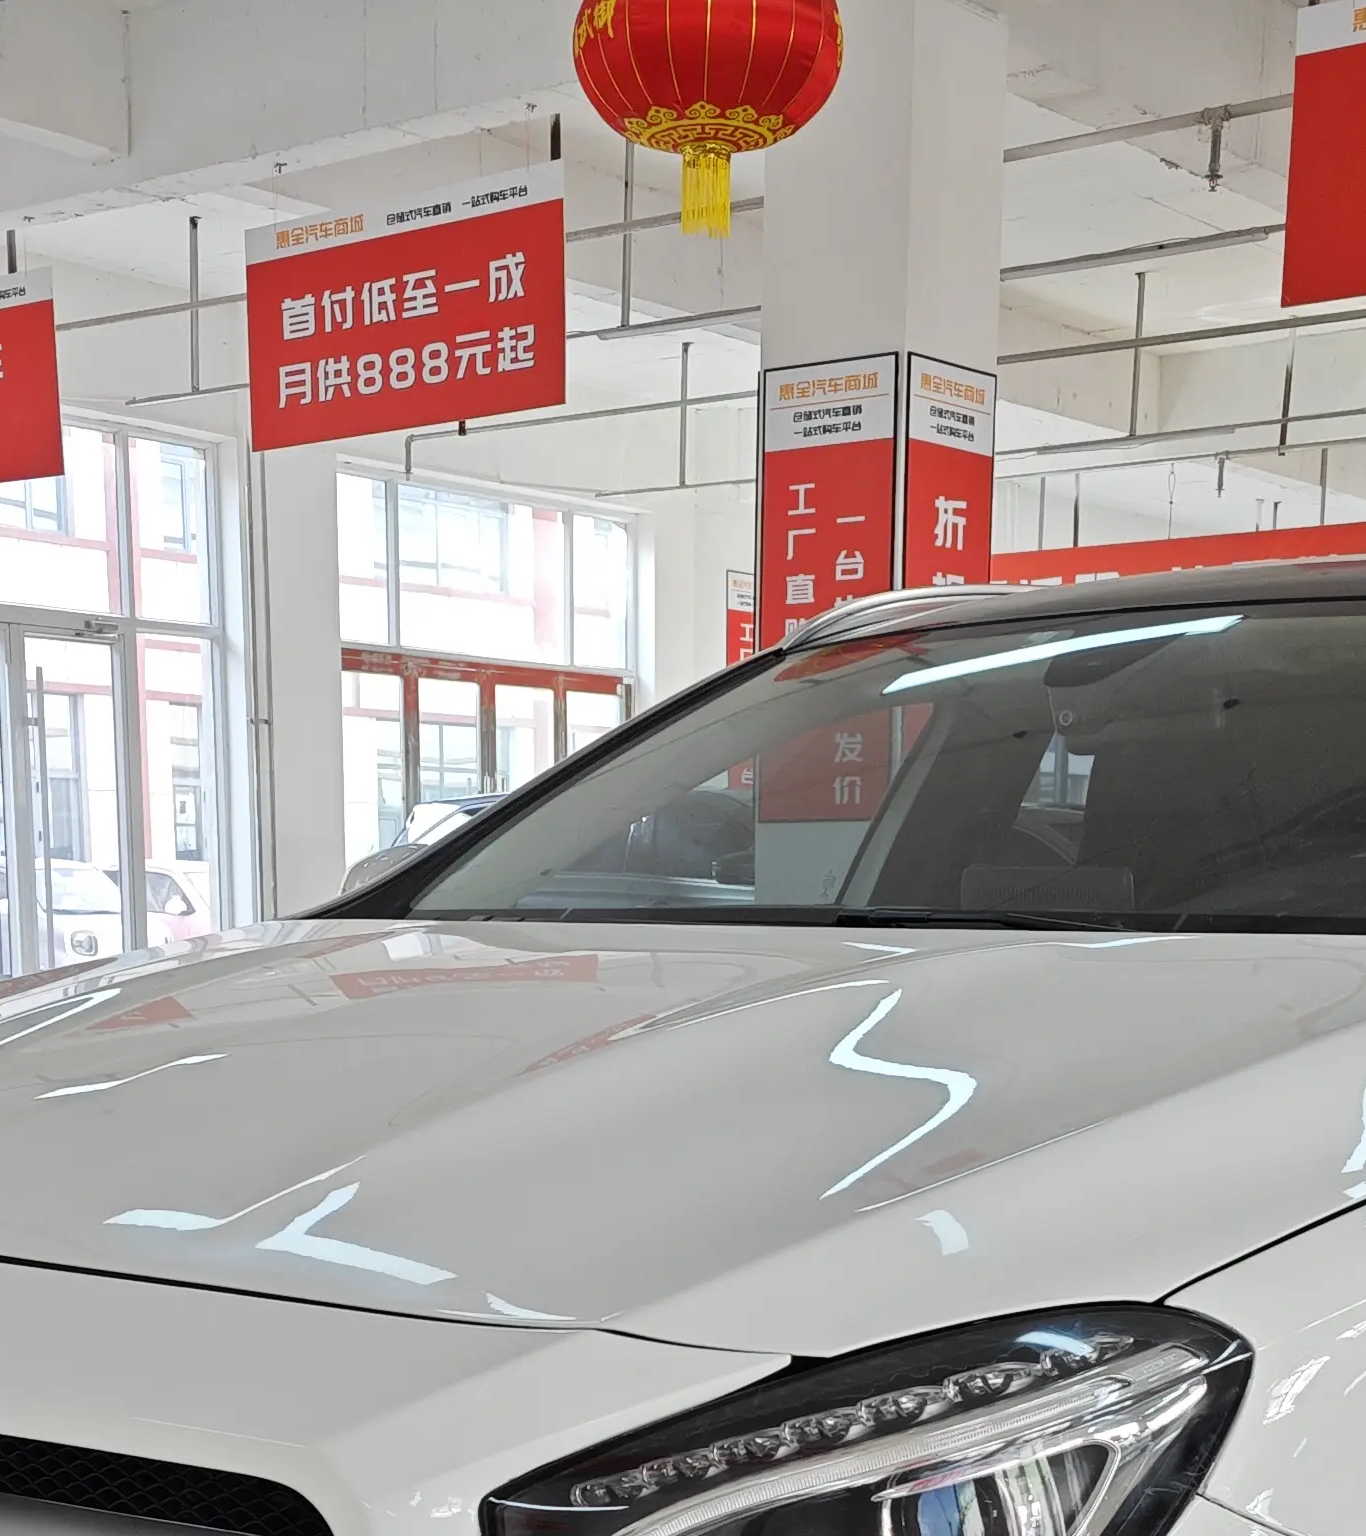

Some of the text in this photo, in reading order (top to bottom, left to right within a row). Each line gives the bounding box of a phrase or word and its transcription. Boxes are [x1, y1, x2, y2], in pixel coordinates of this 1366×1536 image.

[276, 185, 529, 249] 惠全汽车商城 仓储式汽车直销 一站式购车平台
[281, 252, 526, 341] 首付低至一成
[278, 324, 536, 409] 月供888元起
[779, 372, 878, 402] 惠全汽车商城
[920, 373, 985, 405] 惠全汽车商城
[793, 404, 863, 423] 仓储式汽车直销
[793, 420, 862, 437] 一站式购车平台
[834, 515, 866, 608] 一台
